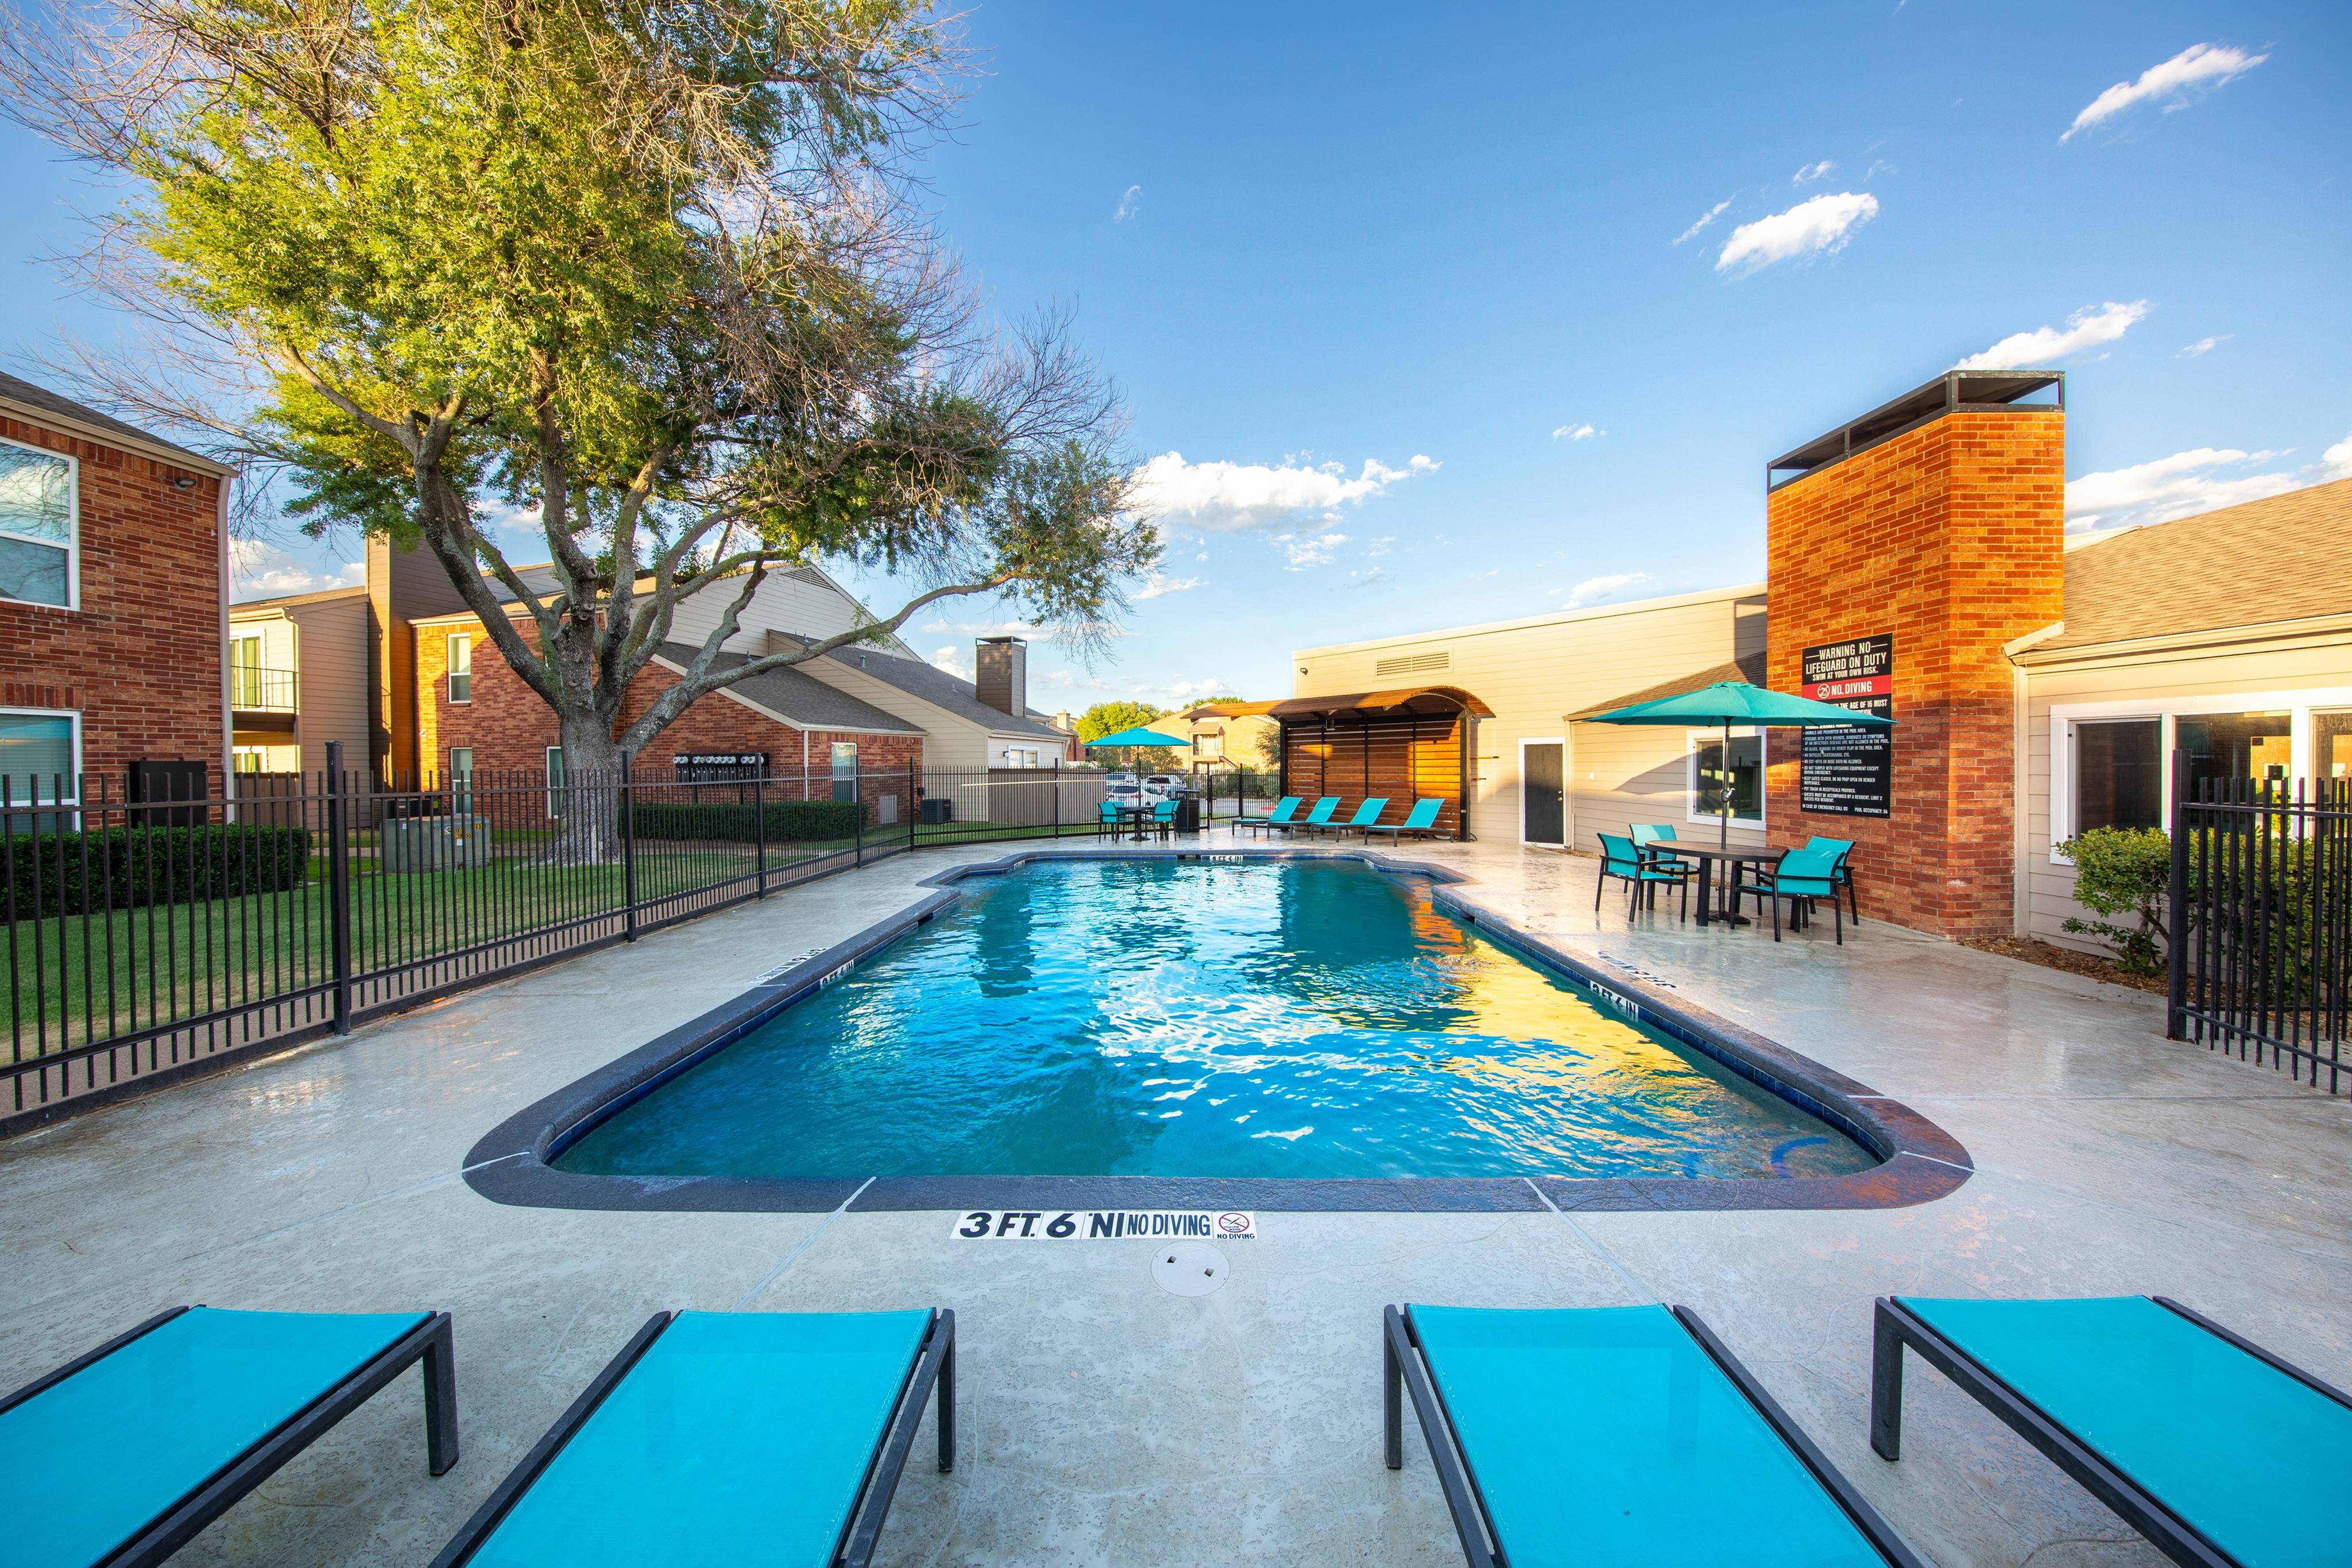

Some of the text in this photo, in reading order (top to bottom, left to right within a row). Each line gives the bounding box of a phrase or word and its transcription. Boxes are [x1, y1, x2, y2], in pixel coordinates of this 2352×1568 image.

[1819, 641, 1871, 660] WARNING NO
[1806, 652, 1887, 674] LIFEGUARD ON DUTY
[1812, 673, 1826, 681] SWIM
[1835, 670, 1848, 678] YOUR
[1849, 668, 1862, 676] OWN
[1863, 666, 1878, 675] RISK.
[1845, 681, 1872, 694] DIVING
[1601, 988, 1613, 1001] FT
[1626, 1000, 1637, 1016] IN
[960, 1212, 992, 1237] 3
[995, 1213, 1042, 1237] FT.
[1046, 1212, 1077, 1238] 6
[1127, 1214, 1149, 1236] NO
[1152, 1214, 1211, 1237] DIVING
